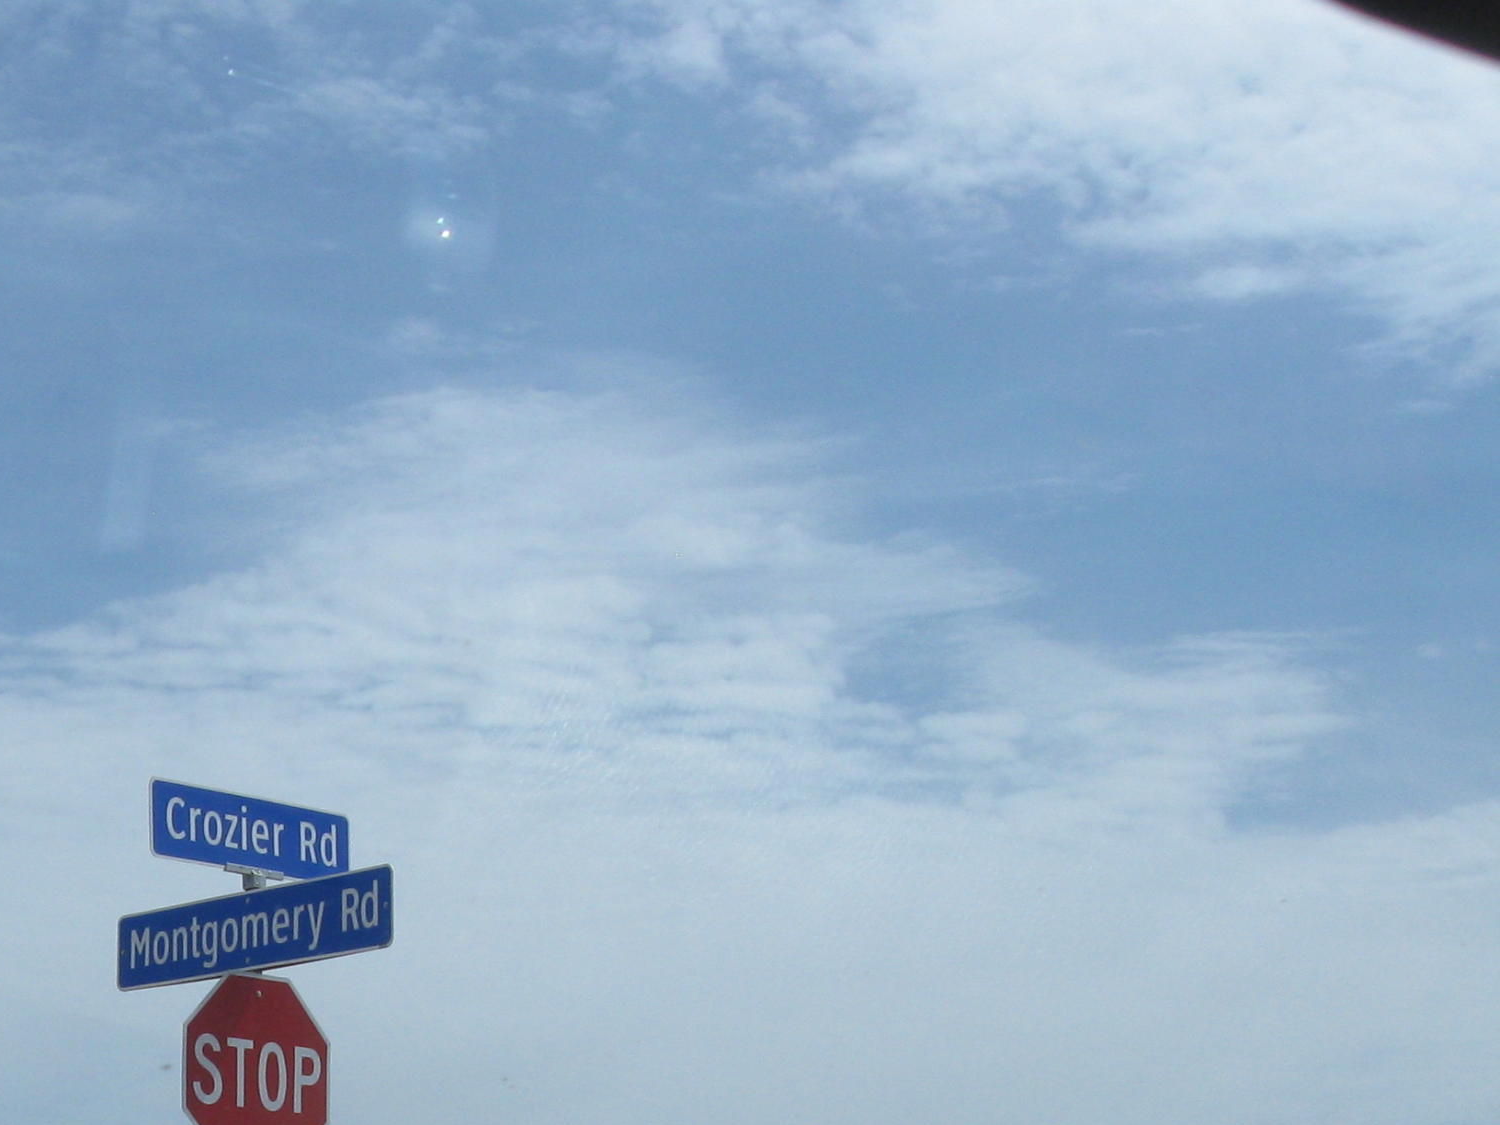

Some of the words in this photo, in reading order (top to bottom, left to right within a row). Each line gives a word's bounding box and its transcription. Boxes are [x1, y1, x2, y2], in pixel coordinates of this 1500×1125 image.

[166, 797, 284, 857] Crozier
[299, 822, 338, 868] Rd
[130, 900, 325, 970] Montgomery
[341, 880, 380, 933] Rd
[192, 1032, 322, 1115] STOP
